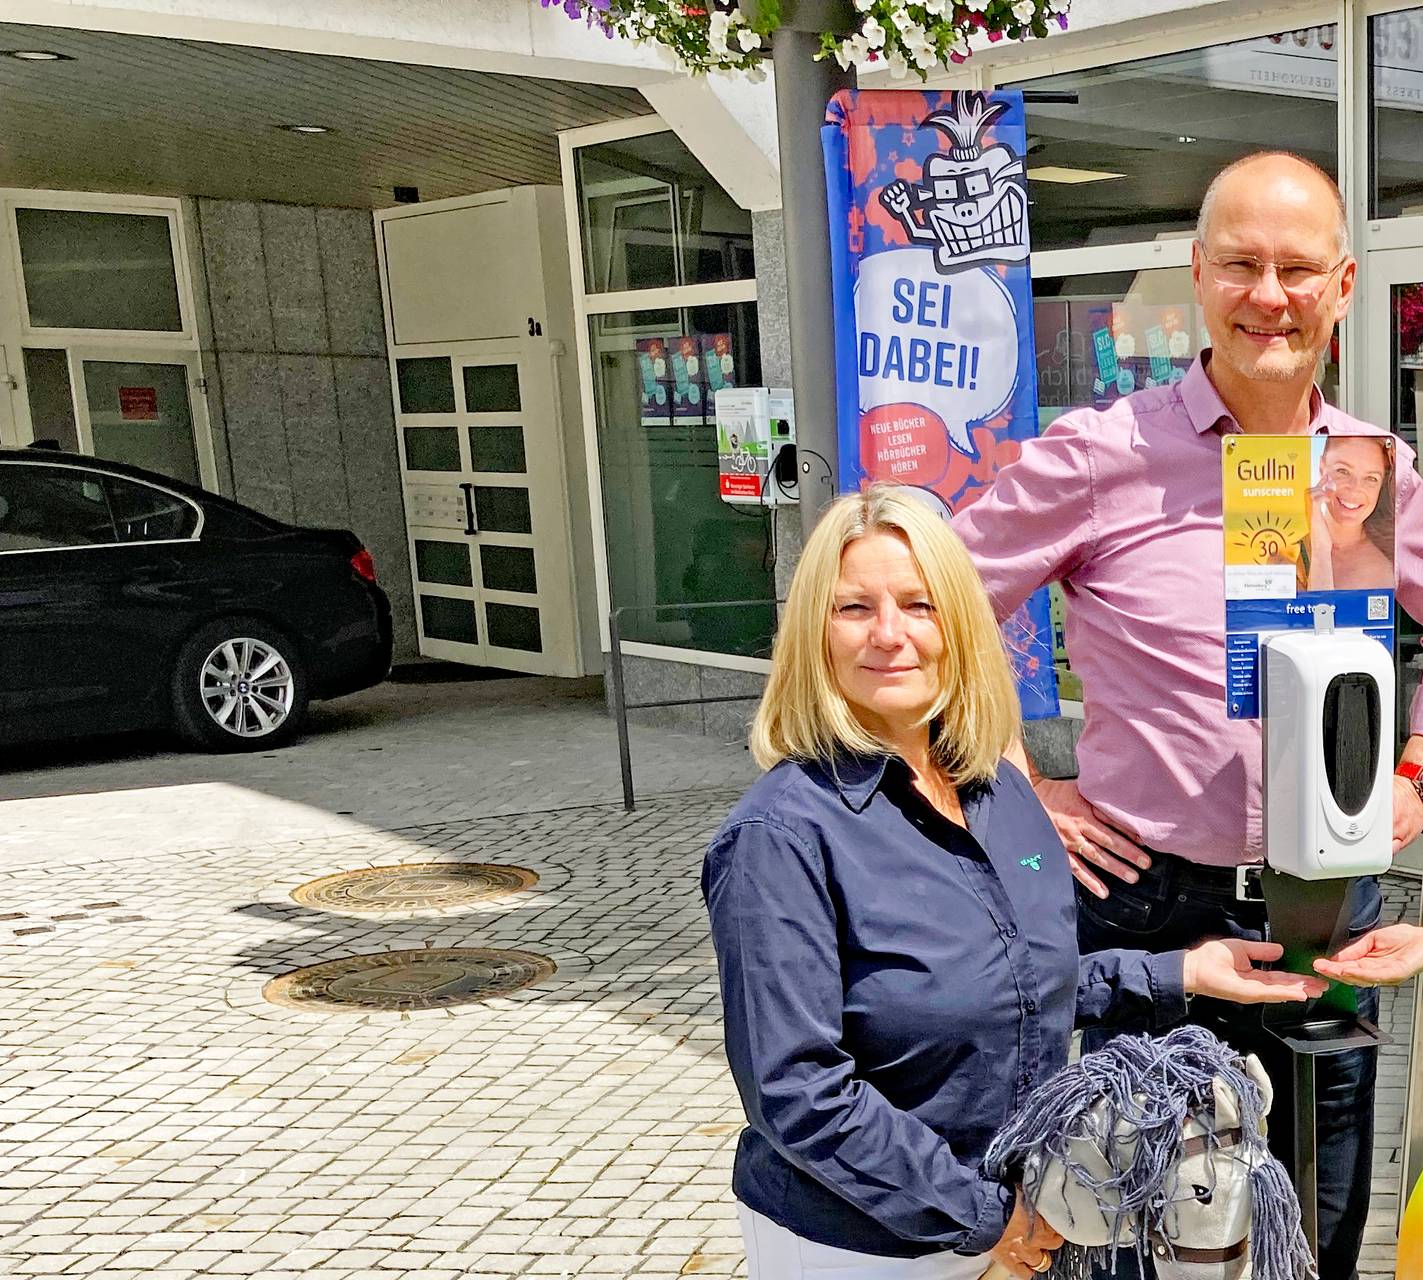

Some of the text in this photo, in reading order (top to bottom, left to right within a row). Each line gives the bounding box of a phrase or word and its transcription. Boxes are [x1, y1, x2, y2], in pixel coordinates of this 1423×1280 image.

[892, 277, 952, 329] SEI
[528, 317, 543, 336] 3a
[859, 331, 980, 391] DABEI!
[870, 416, 926, 435] NEUE BÜCHER
[887, 432, 913, 447] LESEN
[877, 444, 928, 462] HÖRBÜCHER
[891, 460, 919, 475] HÖREN
[1237, 457, 1295, 481] Gullni
[1242, 486, 1294, 497] sunscreen
[1258, 540, 1279, 558] 30
[1286, 603, 1306, 615] free
